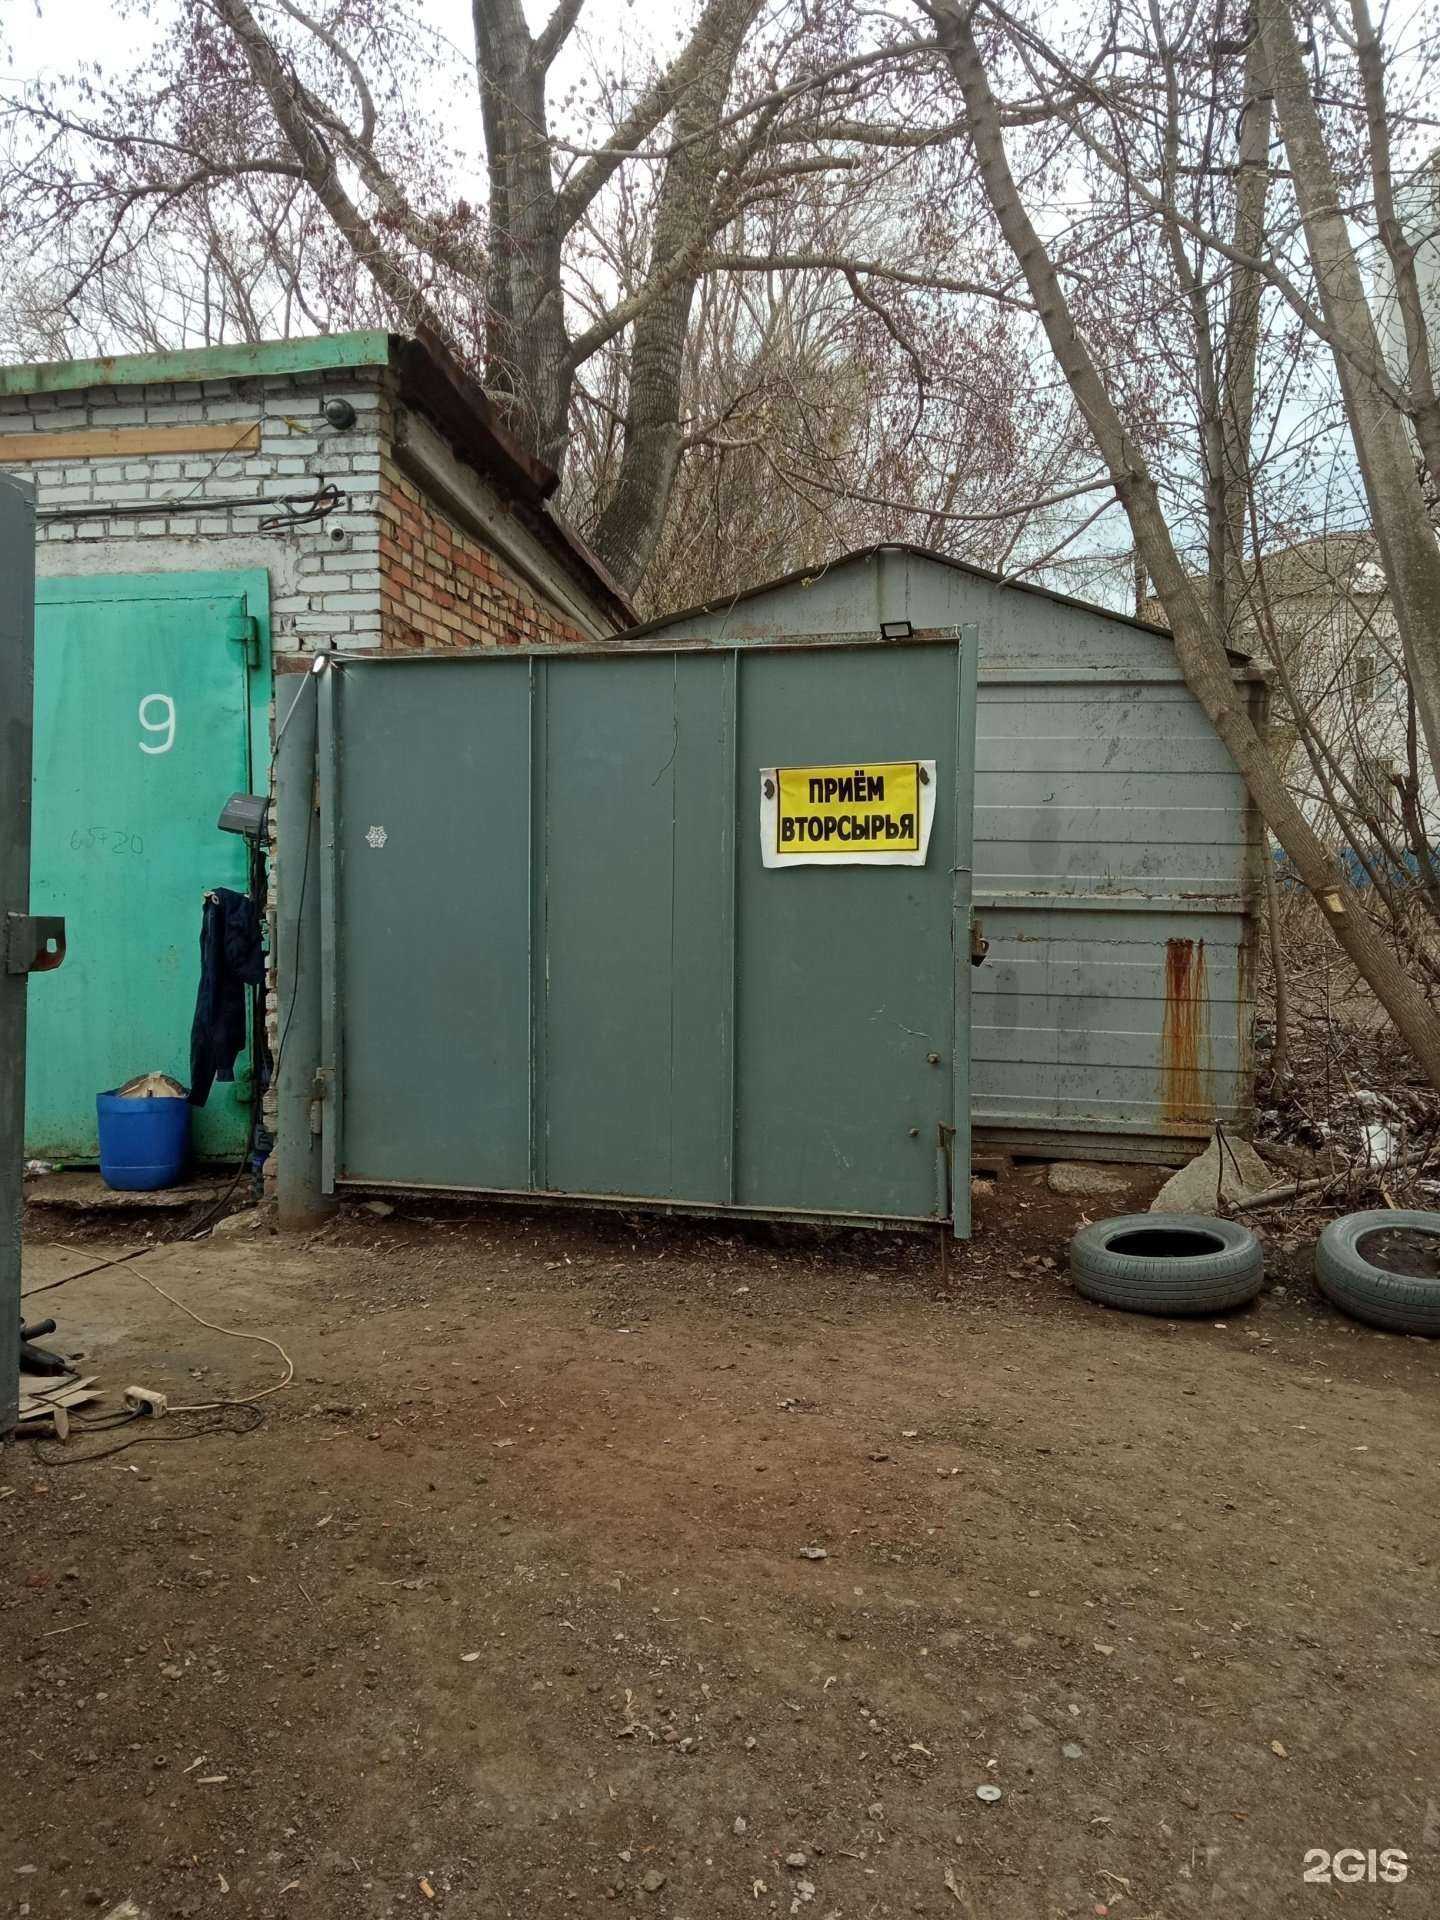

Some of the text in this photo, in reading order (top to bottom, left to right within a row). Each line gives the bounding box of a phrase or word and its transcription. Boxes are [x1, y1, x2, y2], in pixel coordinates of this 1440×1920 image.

[138, 693, 176, 754] 9
[808, 770, 884, 803] ПРИЁМ
[781, 813, 914, 842] ВТОРСЫРЬЯ
